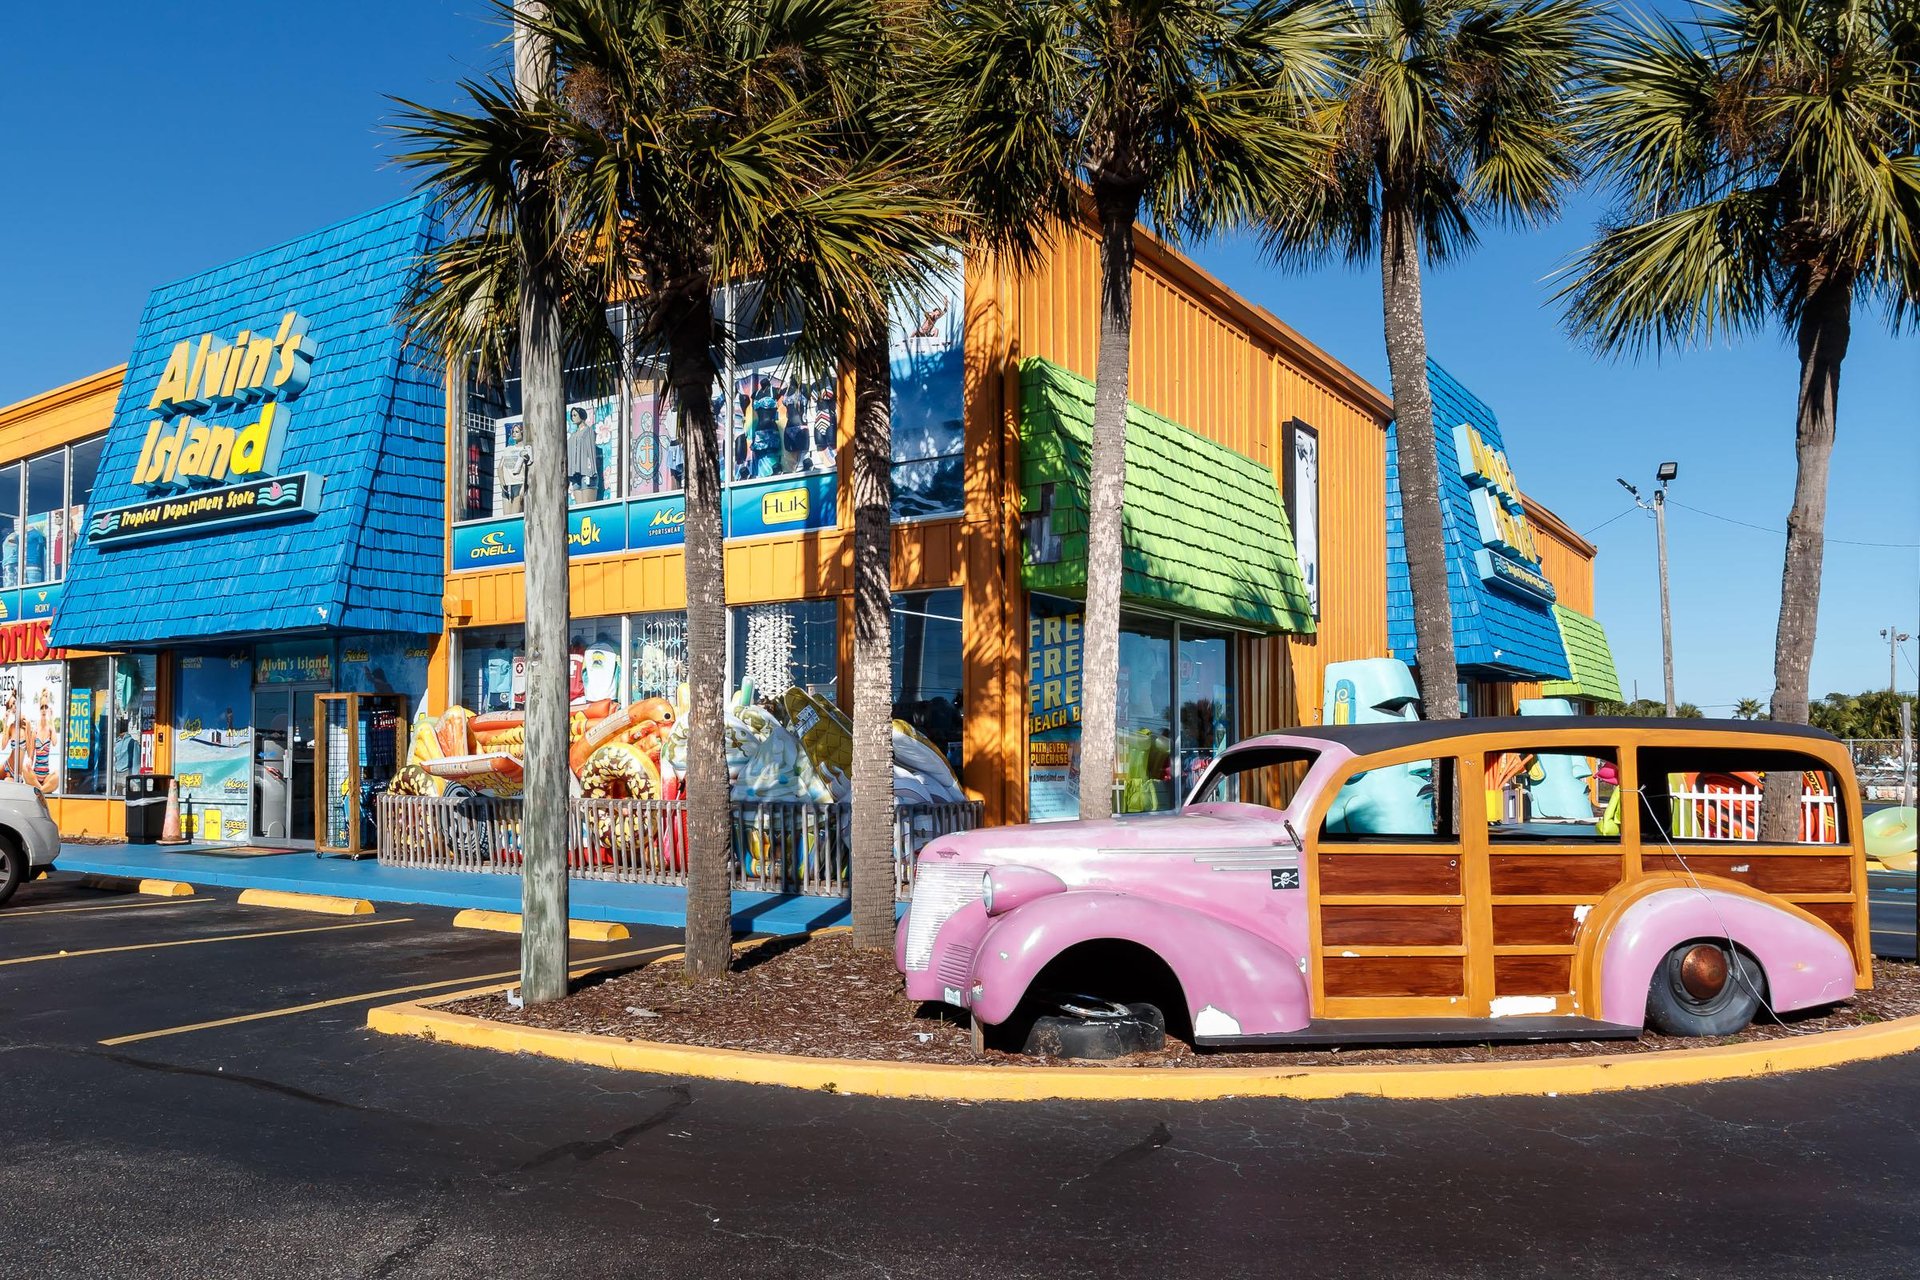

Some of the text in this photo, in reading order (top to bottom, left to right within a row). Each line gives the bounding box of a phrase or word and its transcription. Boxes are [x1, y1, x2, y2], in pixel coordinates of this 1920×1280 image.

[148, 311, 306, 411] Alvin's
[131, 402, 279, 486] Island
[121, 490, 256, 527] Tropical Department Store
[764, 496, 808, 515] Huk
[649, 526, 681, 536] SPORTSWEAR
[470, 543, 516, 559] O'NEILL
[34, 603, 51, 614] ROXY
[1029, 613, 1086, 648] FRE
[261, 657, 294, 672] Alvin's
[297, 655, 329, 669] Island
[1029, 644, 1081, 680] FRE
[1028, 674, 1081, 714] FRE
[70, 701, 89, 717] BIG
[69, 719, 89, 743] SALE
[1031, 742, 1069, 753] WITH EVERY
[1031, 753, 1069, 764] PURCHASE
